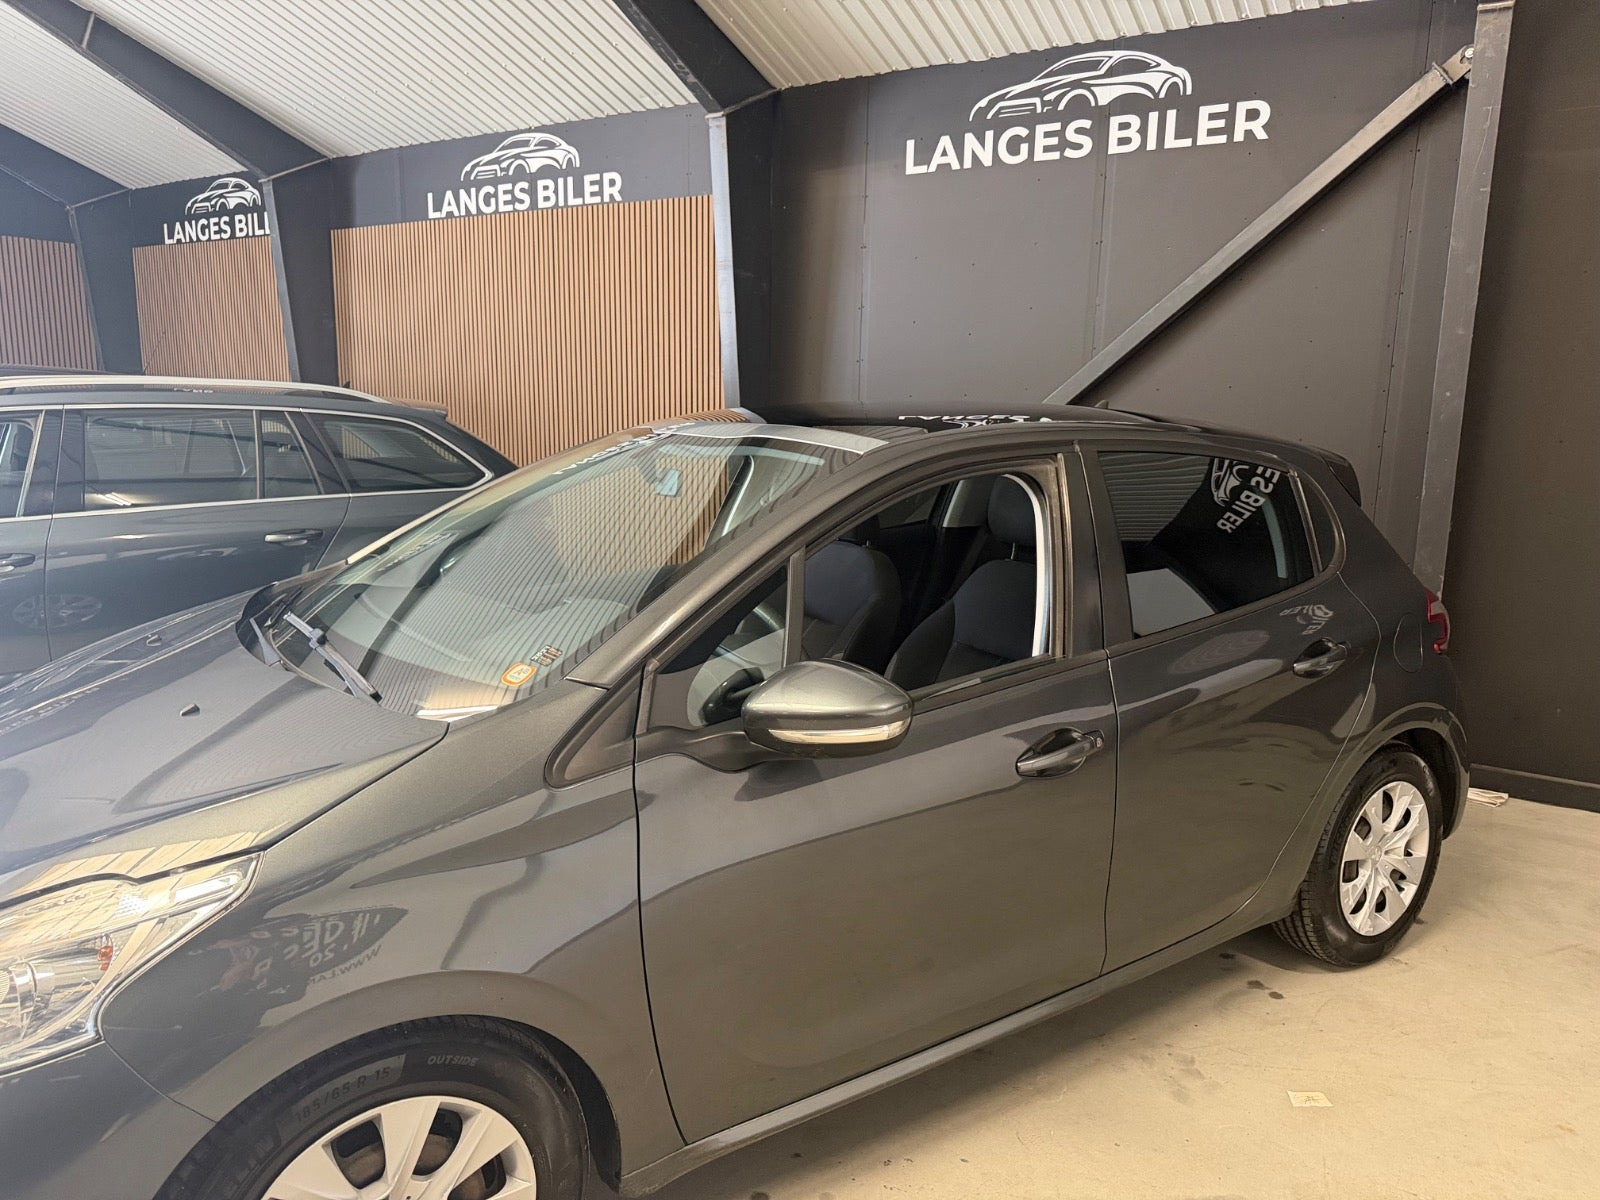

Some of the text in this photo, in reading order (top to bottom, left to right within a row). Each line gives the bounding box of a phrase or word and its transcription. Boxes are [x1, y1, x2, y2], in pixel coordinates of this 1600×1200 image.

[904, 99, 1271, 175] LANGES BILER
[427, 171, 623, 219] LANGES BILER
[163, 216, 231, 245] LANGES
[427, 1055, 480, 1067] OUTSIDE
[356, 1074, 367, 1089] R
[373, 1066, 391, 1081] 15
